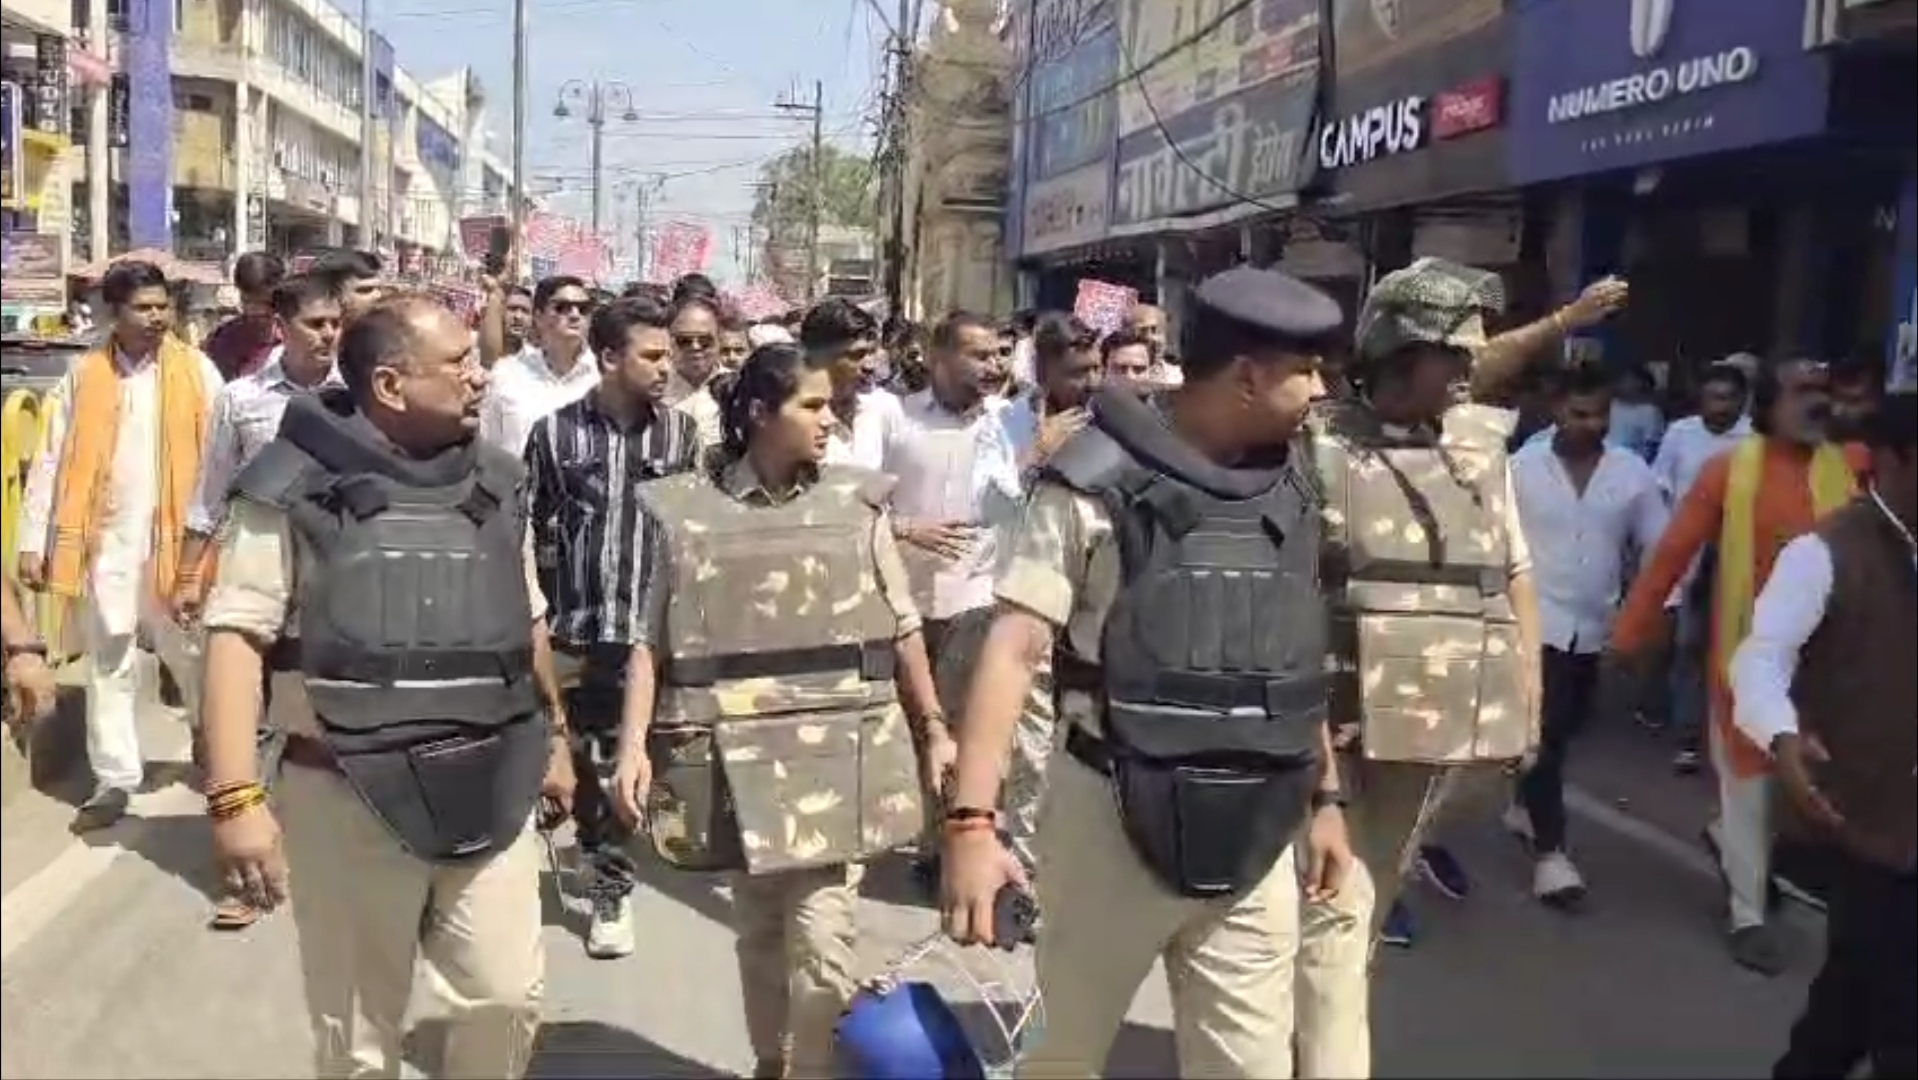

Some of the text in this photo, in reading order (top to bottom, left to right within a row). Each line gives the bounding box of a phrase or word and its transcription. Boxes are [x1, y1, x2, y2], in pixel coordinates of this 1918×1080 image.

[1548, 68, 1670, 123] NUMERO
[1677, 47, 1756, 92] UNO
[1320, 97, 1420, 169] CAMPUS
